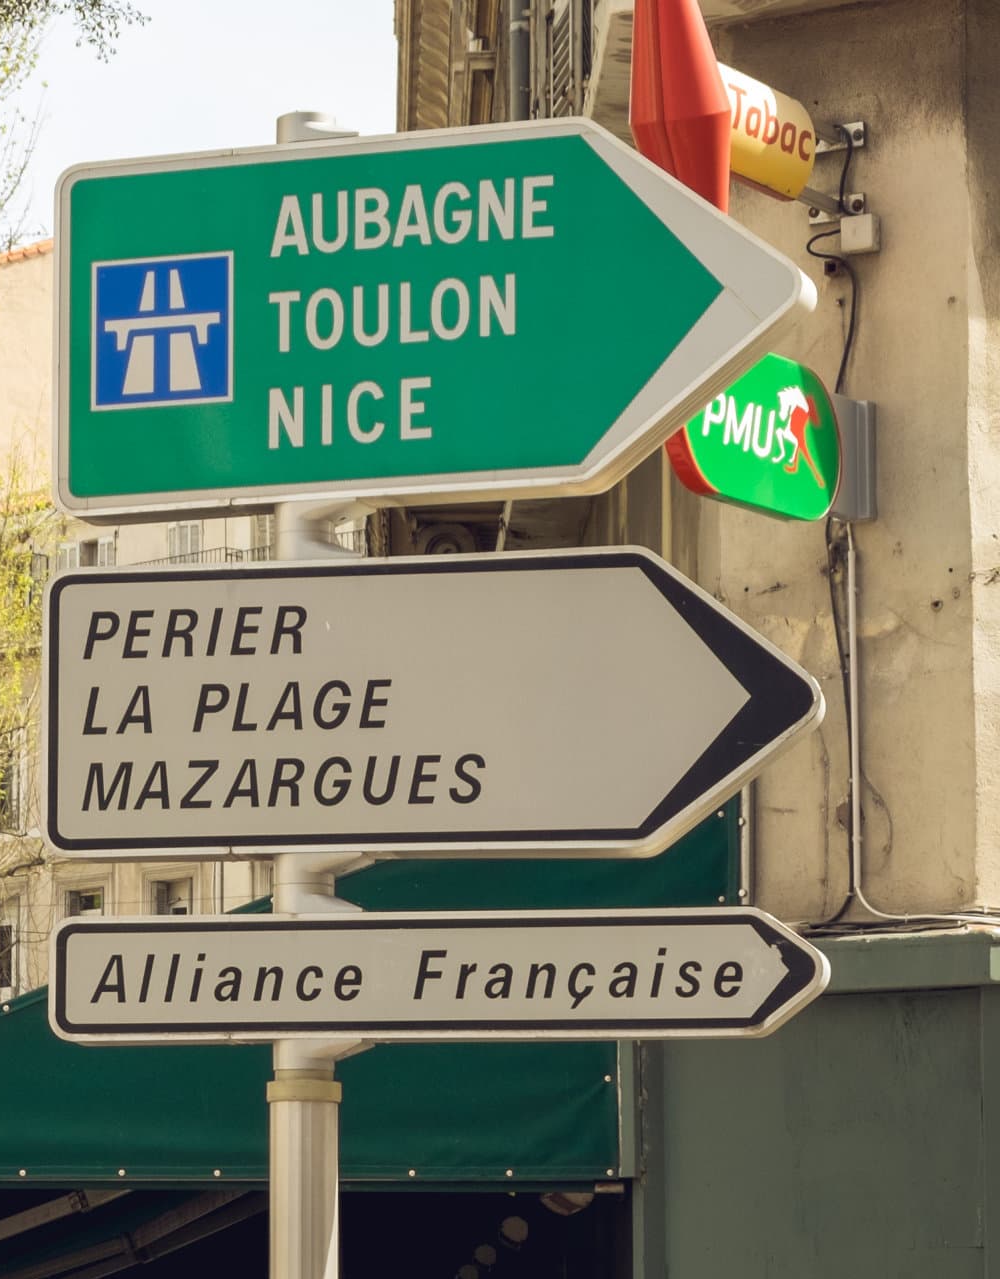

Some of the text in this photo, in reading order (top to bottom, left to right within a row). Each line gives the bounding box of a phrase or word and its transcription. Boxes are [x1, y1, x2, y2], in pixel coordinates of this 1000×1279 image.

[727, 82, 813, 162] Tabac
[270, 174, 555, 258] AUBAGNE
[268, 273, 516, 353] TOULON
[268, 376, 433, 450] NICE
[702, 393, 776, 458] PMU
[82, 605, 308, 660] PERIER
[82, 678, 393, 736] LA PLAGE
[81, 753, 486, 812] MAZARGUES
[90, 946, 745, 1010] Alliance Française
